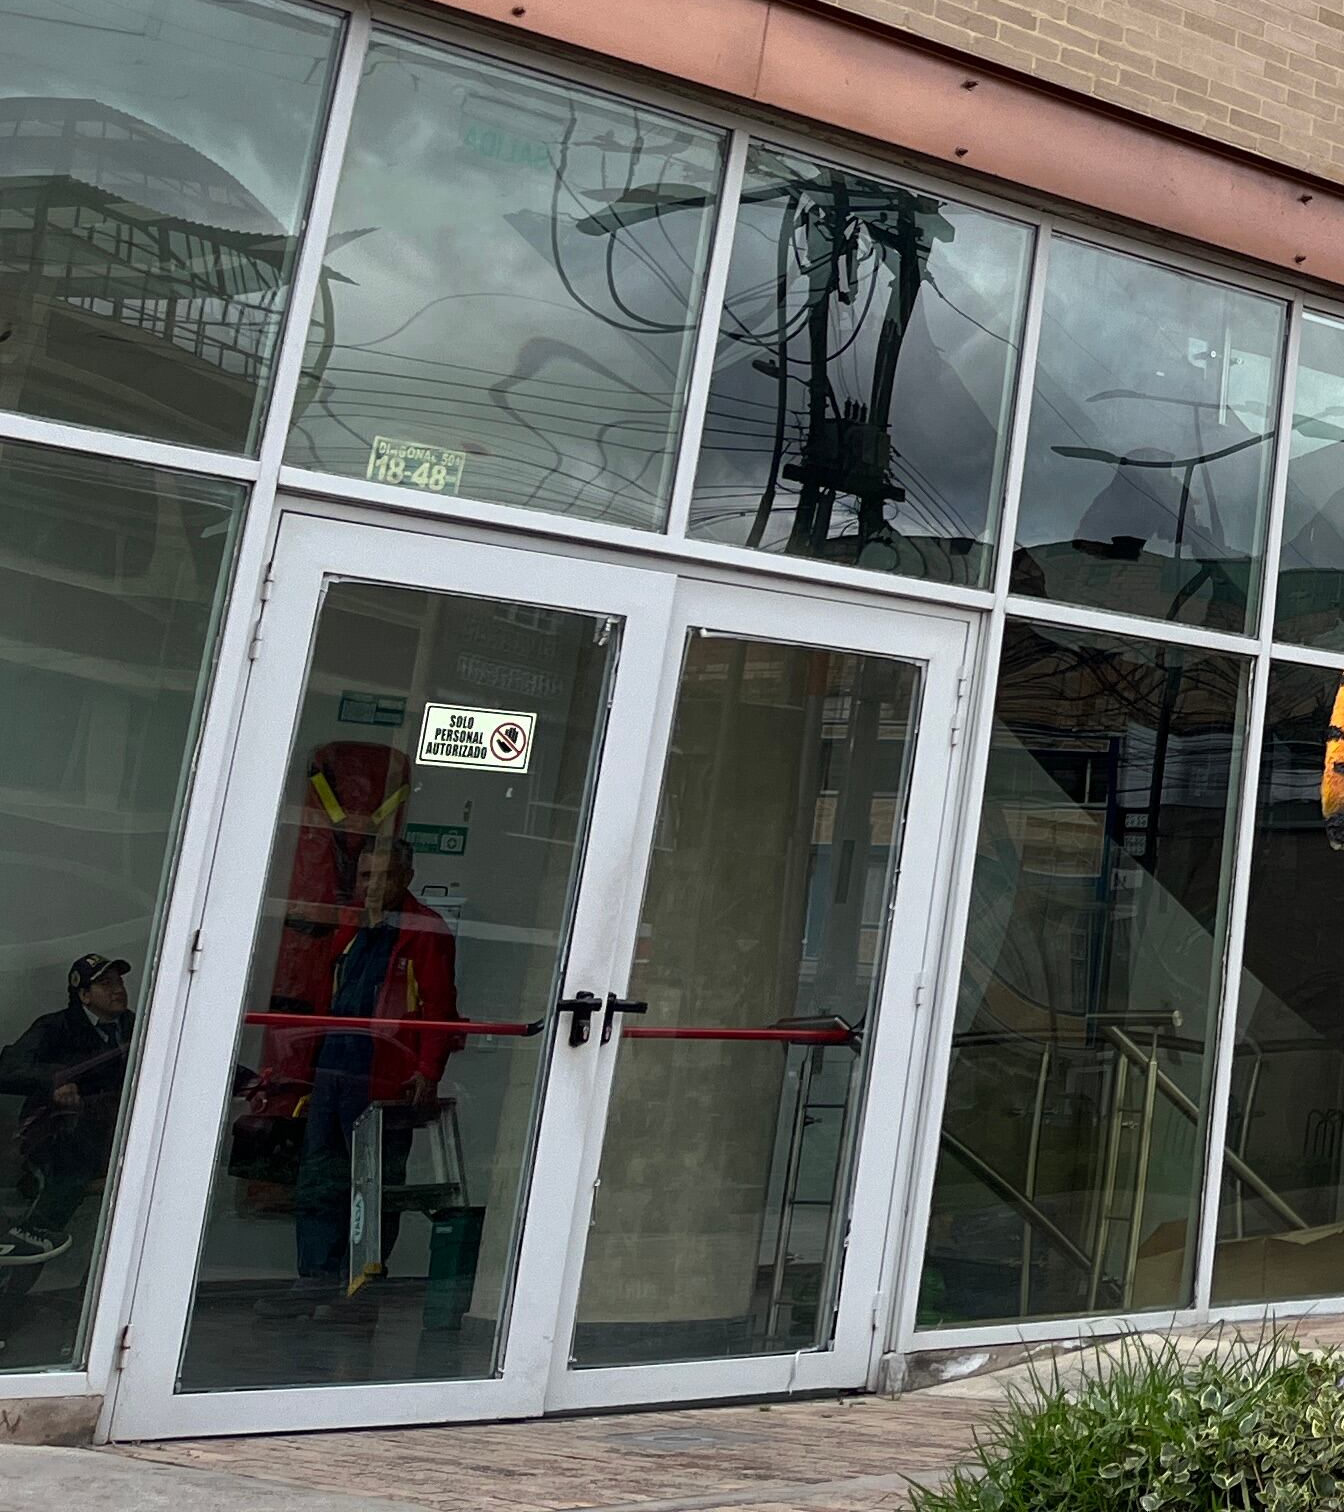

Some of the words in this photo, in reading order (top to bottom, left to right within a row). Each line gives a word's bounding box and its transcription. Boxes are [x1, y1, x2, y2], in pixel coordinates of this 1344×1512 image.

[375, 454, 447, 491] 18-48
[449, 714, 475, 730] SOLO
[434, 727, 484, 745] PERSONAL
[425, 741, 488, 760] AUTORIZADO
